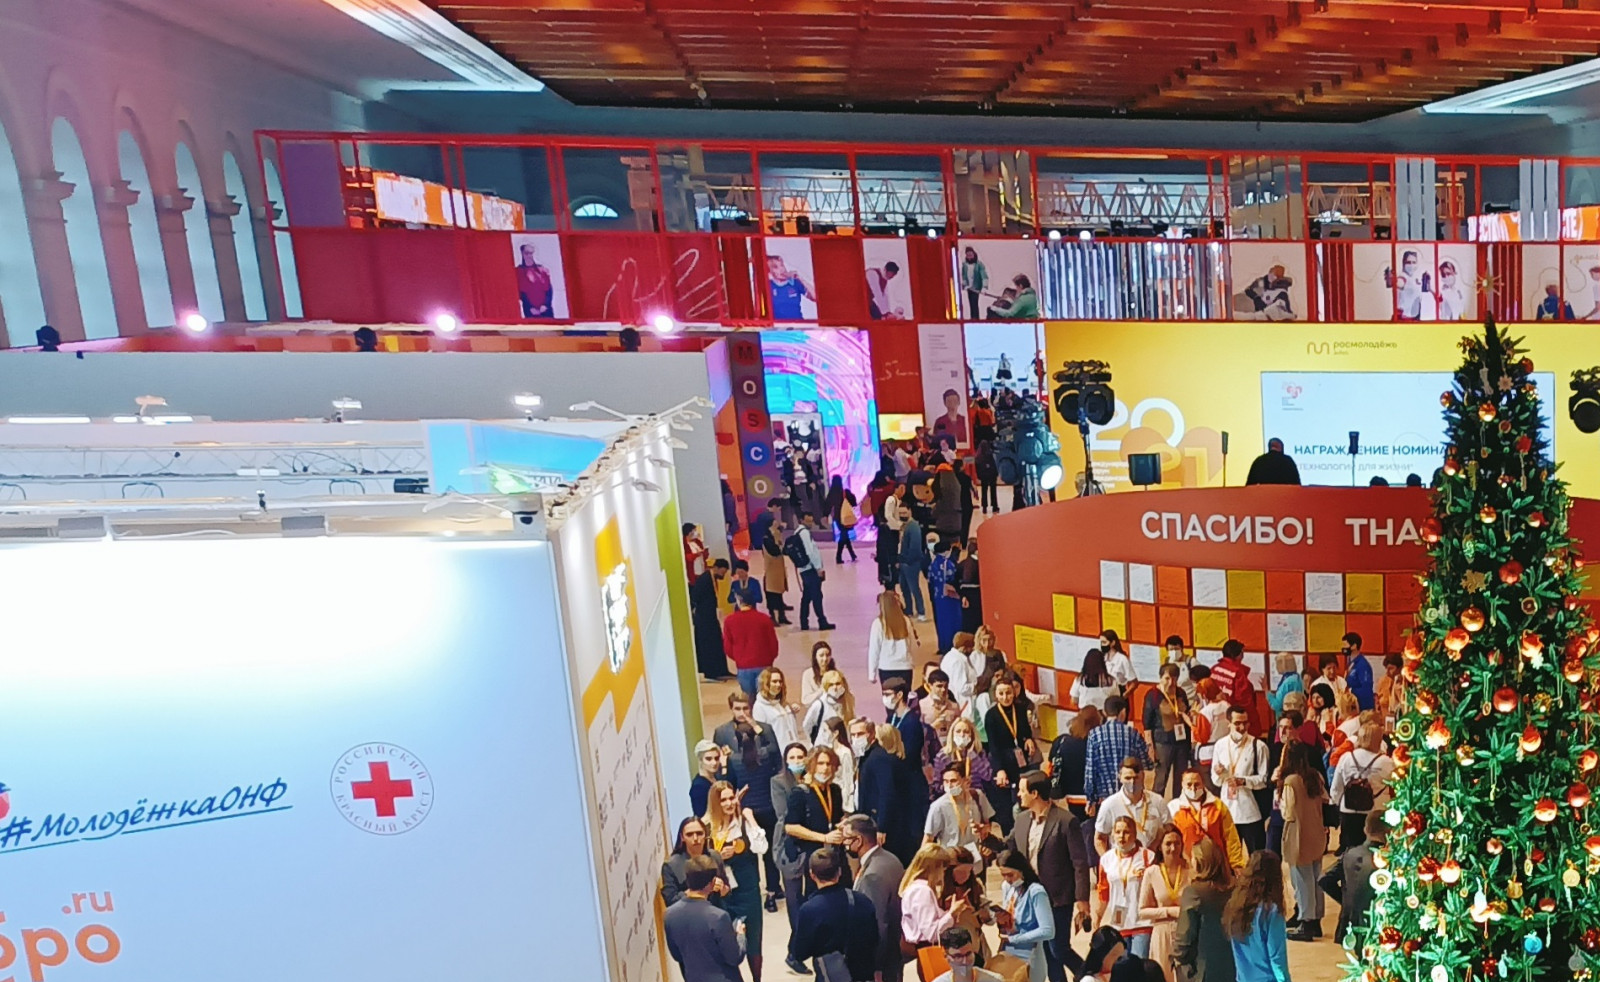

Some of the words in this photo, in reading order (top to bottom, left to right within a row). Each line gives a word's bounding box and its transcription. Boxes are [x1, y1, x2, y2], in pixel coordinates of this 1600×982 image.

[737, 345, 768, 494] MOSCO
[1294, 445, 1389, 456] НАГРАЖЕНИЕ
[1392, 445, 1446, 456] НОМИНА
[1141, 510, 1314, 546] СПАСИБО!
[1345, 517, 1423, 547] THA
[334, 744, 428, 784] РОССИЙСКИЙ
[1, 777, 289, 849] #МолодёжкаОНФ
[335, 794, 398, 833] КРАСНЫЙ
[402, 791, 431, 828] КРЕСТ
